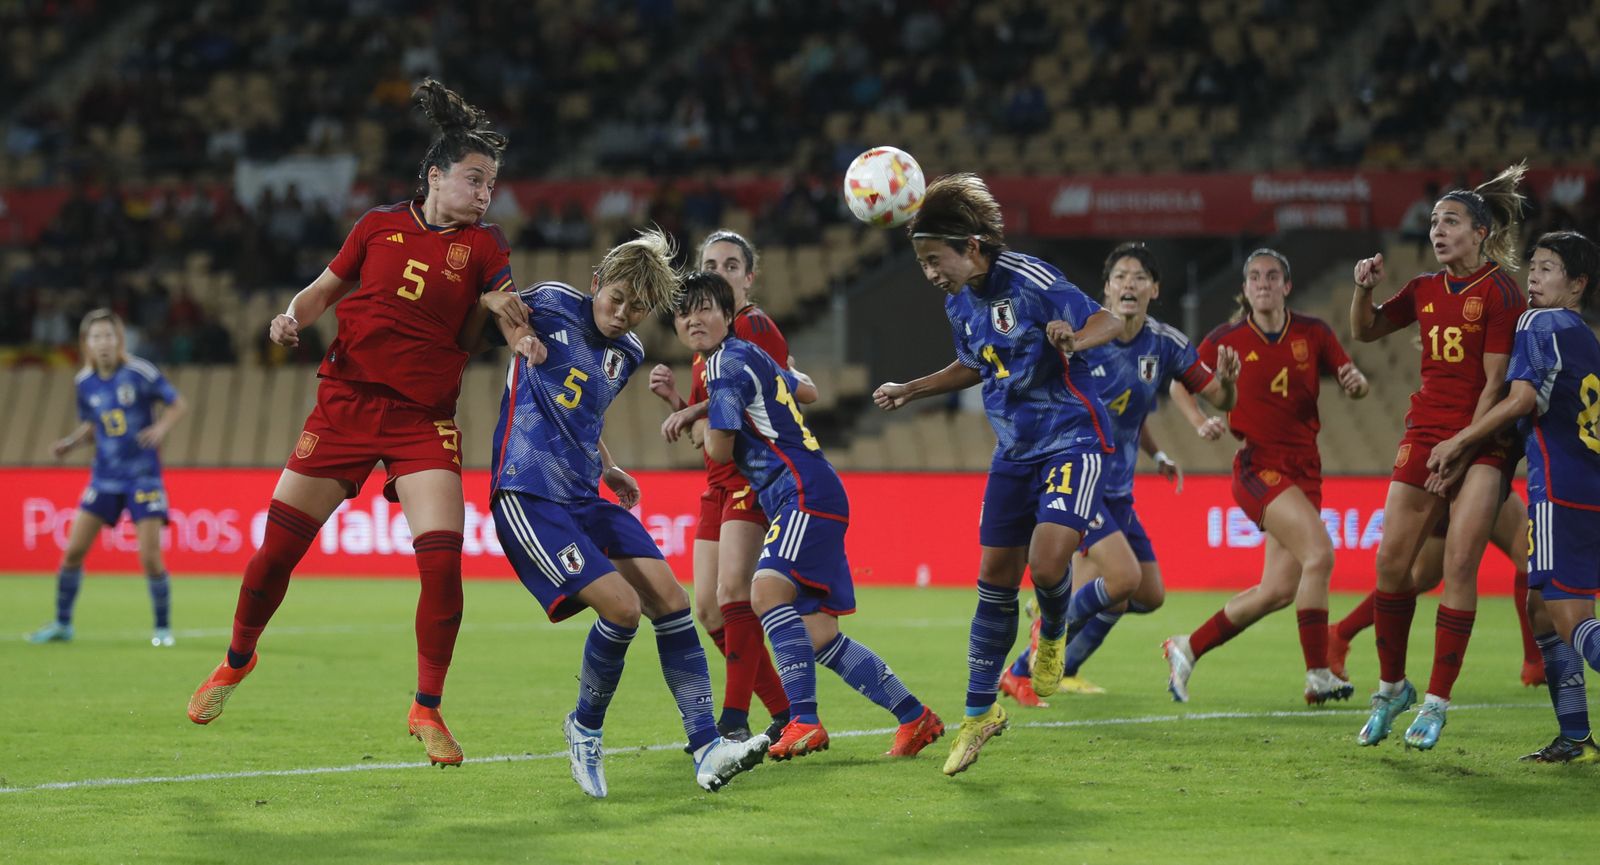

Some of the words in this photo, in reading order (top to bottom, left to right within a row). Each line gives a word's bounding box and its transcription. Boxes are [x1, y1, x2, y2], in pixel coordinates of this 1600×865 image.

[397, 259, 429, 301] 5
[1428, 325, 1464, 363] 18
[556, 367, 589, 409] 5
[1271, 367, 1288, 398] 4
[1110, 389, 1132, 416] 4
[102, 408, 127, 437] 13
[433, 420, 458, 452] 5
[23, 497, 243, 554] Poeos
[1207, 506, 1386, 550] IBRIA
